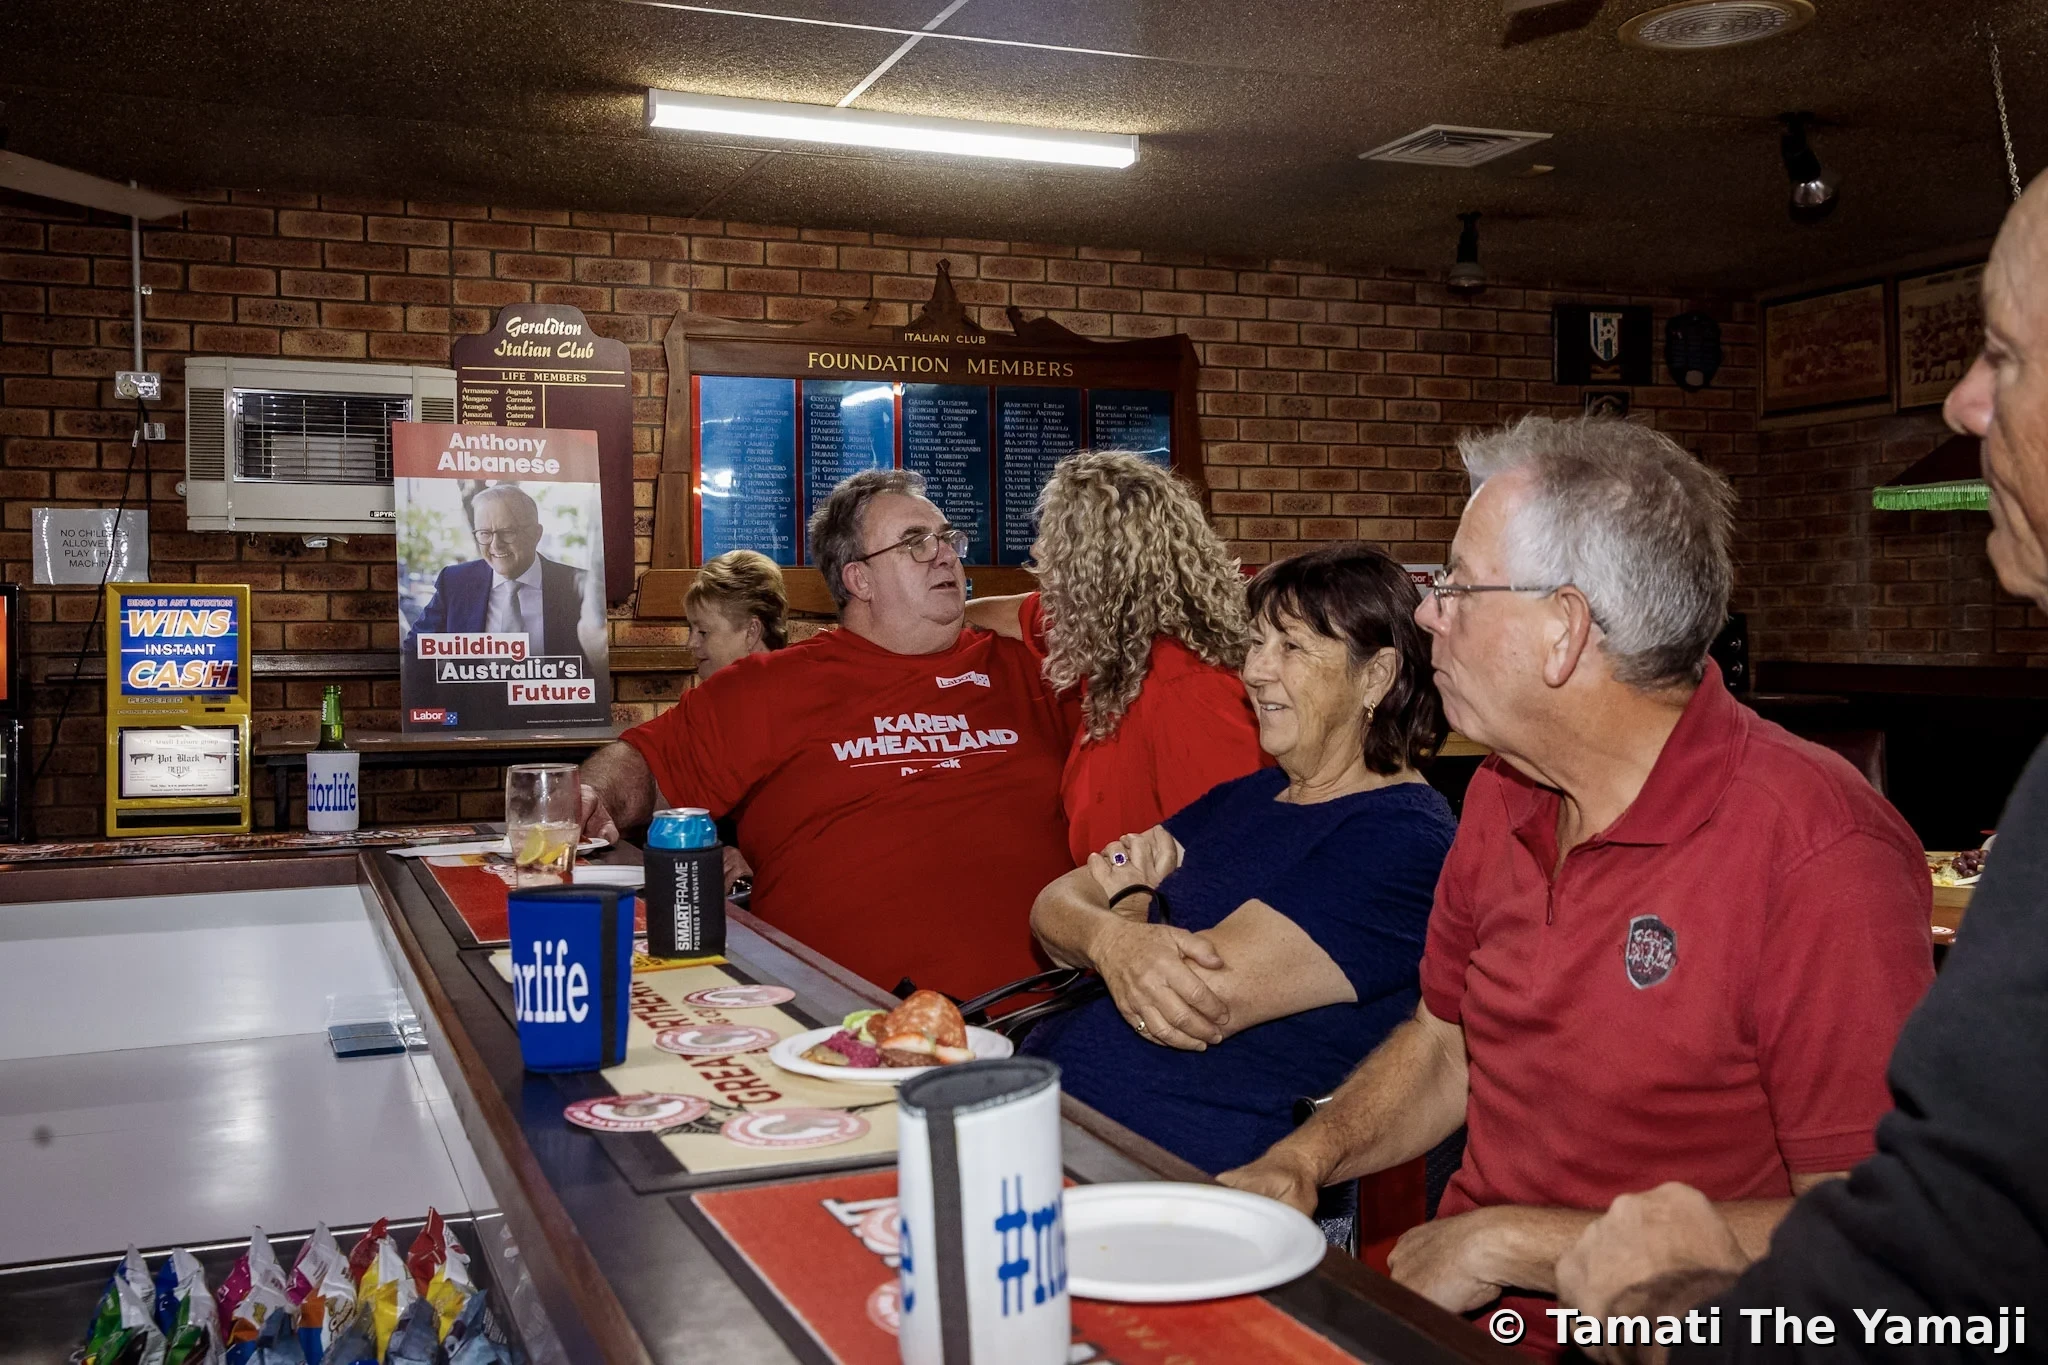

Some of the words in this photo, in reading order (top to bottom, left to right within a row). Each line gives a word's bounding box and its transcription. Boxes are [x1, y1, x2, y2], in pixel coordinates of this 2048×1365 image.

[505, 316, 582, 337] Geraldton
[904, 333, 950, 343] ITALIAN
[956, 335, 986, 345] CLUB
[494, 339, 551, 357] Italian
[557, 341, 594, 359] Club
[807, 352, 950, 372] FOUNDATION
[967, 358, 1074, 377] MEMBERS
[502, 372, 526, 381] LIFE
[534, 373, 587, 382] MEMBERS
[462, 395, 492, 403] Mangano
[506, 388, 532, 396] Augusto
[462, 403, 488, 411] Arangio
[449, 433, 547, 458] Anthony
[437, 451, 560, 475] Albanese
[60, 529, 76, 537] NO
[64, 549, 90, 557] PLAY
[1411, 573, 1427, 583] bor
[128, 609, 231, 637] WINS
[145, 644, 216, 655] INSTANT
[421, 635, 526, 660] Building
[128, 660, 233, 688] CASH
[440, 659, 578, 680] Australia's
[940, 673, 973, 687] Labor
[512, 684, 591, 702] Future
[413, 711, 443, 721] Labor
[874, 713, 969, 733] KAREN
[831, 729, 1019, 761] WHEATLAND
[692, 861, 700, 905] INNOVATION
[675, 862, 690, 950] SMARTFRAME
[693, 906, 700, 914] BY
